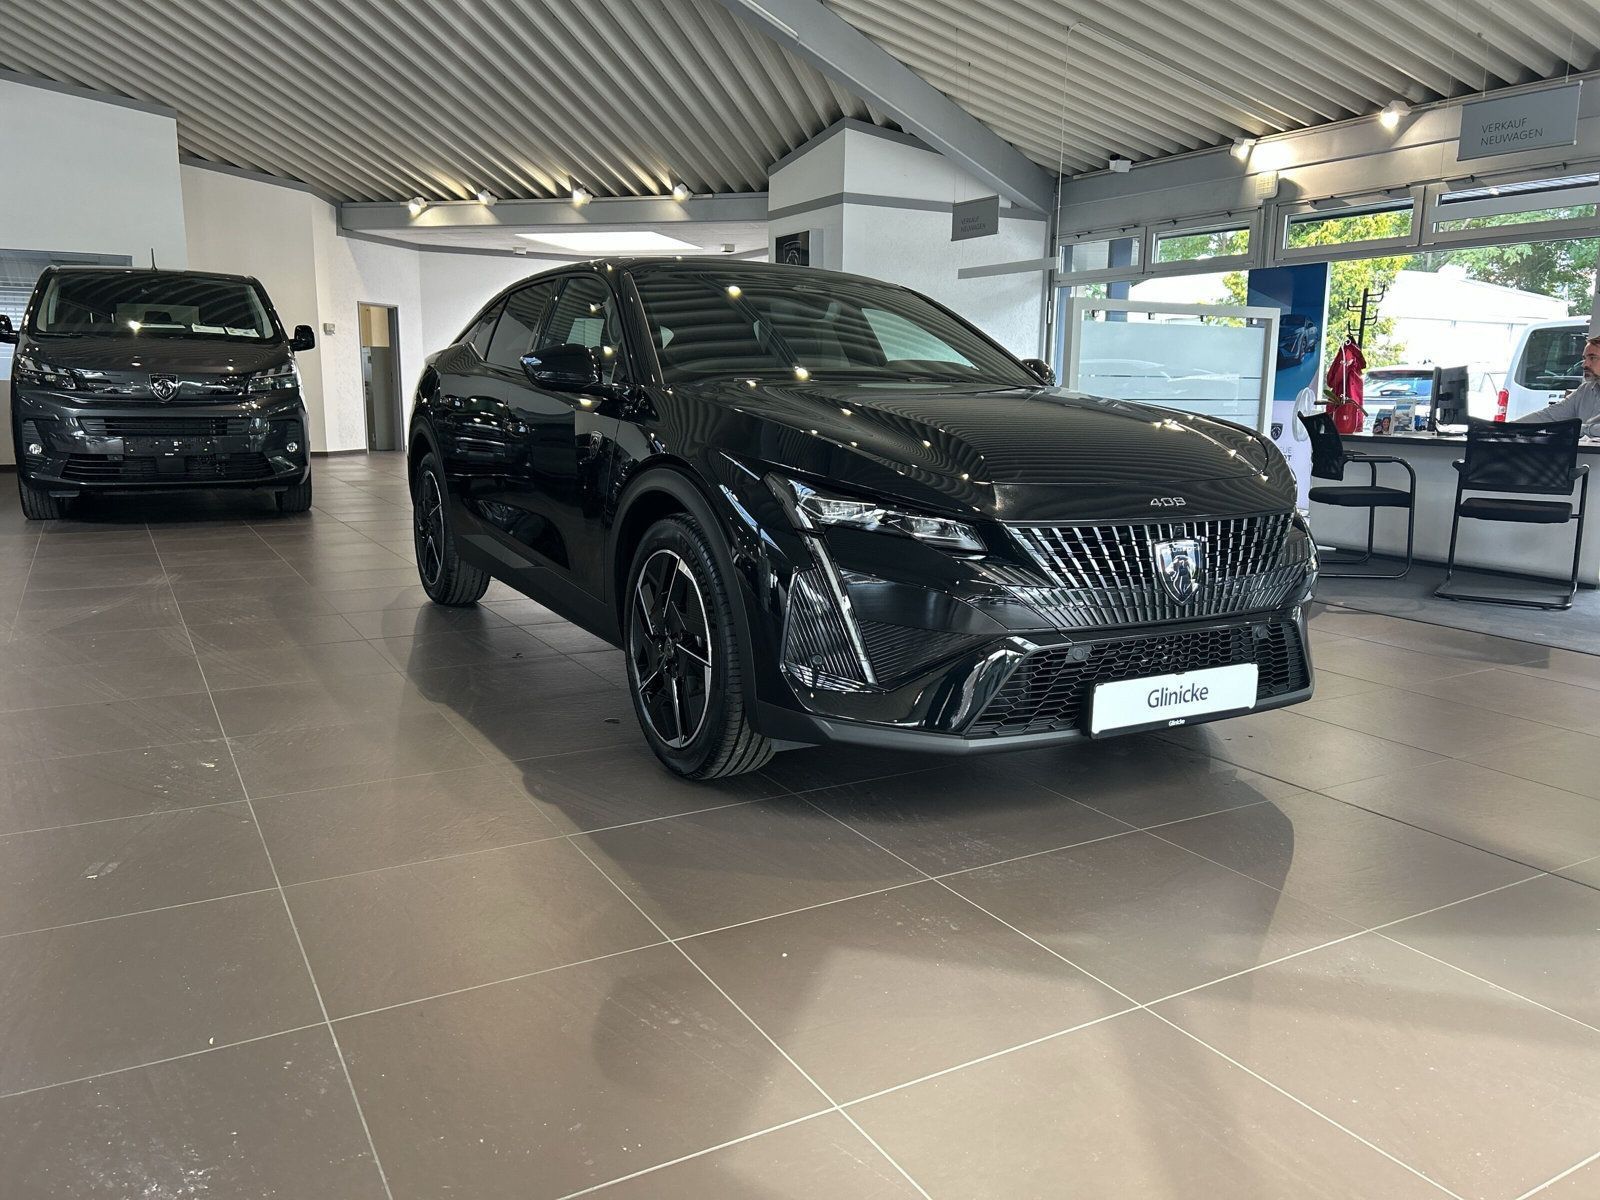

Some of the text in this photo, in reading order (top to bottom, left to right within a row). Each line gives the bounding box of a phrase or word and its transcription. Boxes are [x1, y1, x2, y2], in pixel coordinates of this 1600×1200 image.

[1481, 117, 1527, 133] VERKAUF
[1481, 128, 1543, 146] NEUWAGEN
[1150, 497, 1187, 507] 408
[1147, 683, 1209, 708] Glinicke
